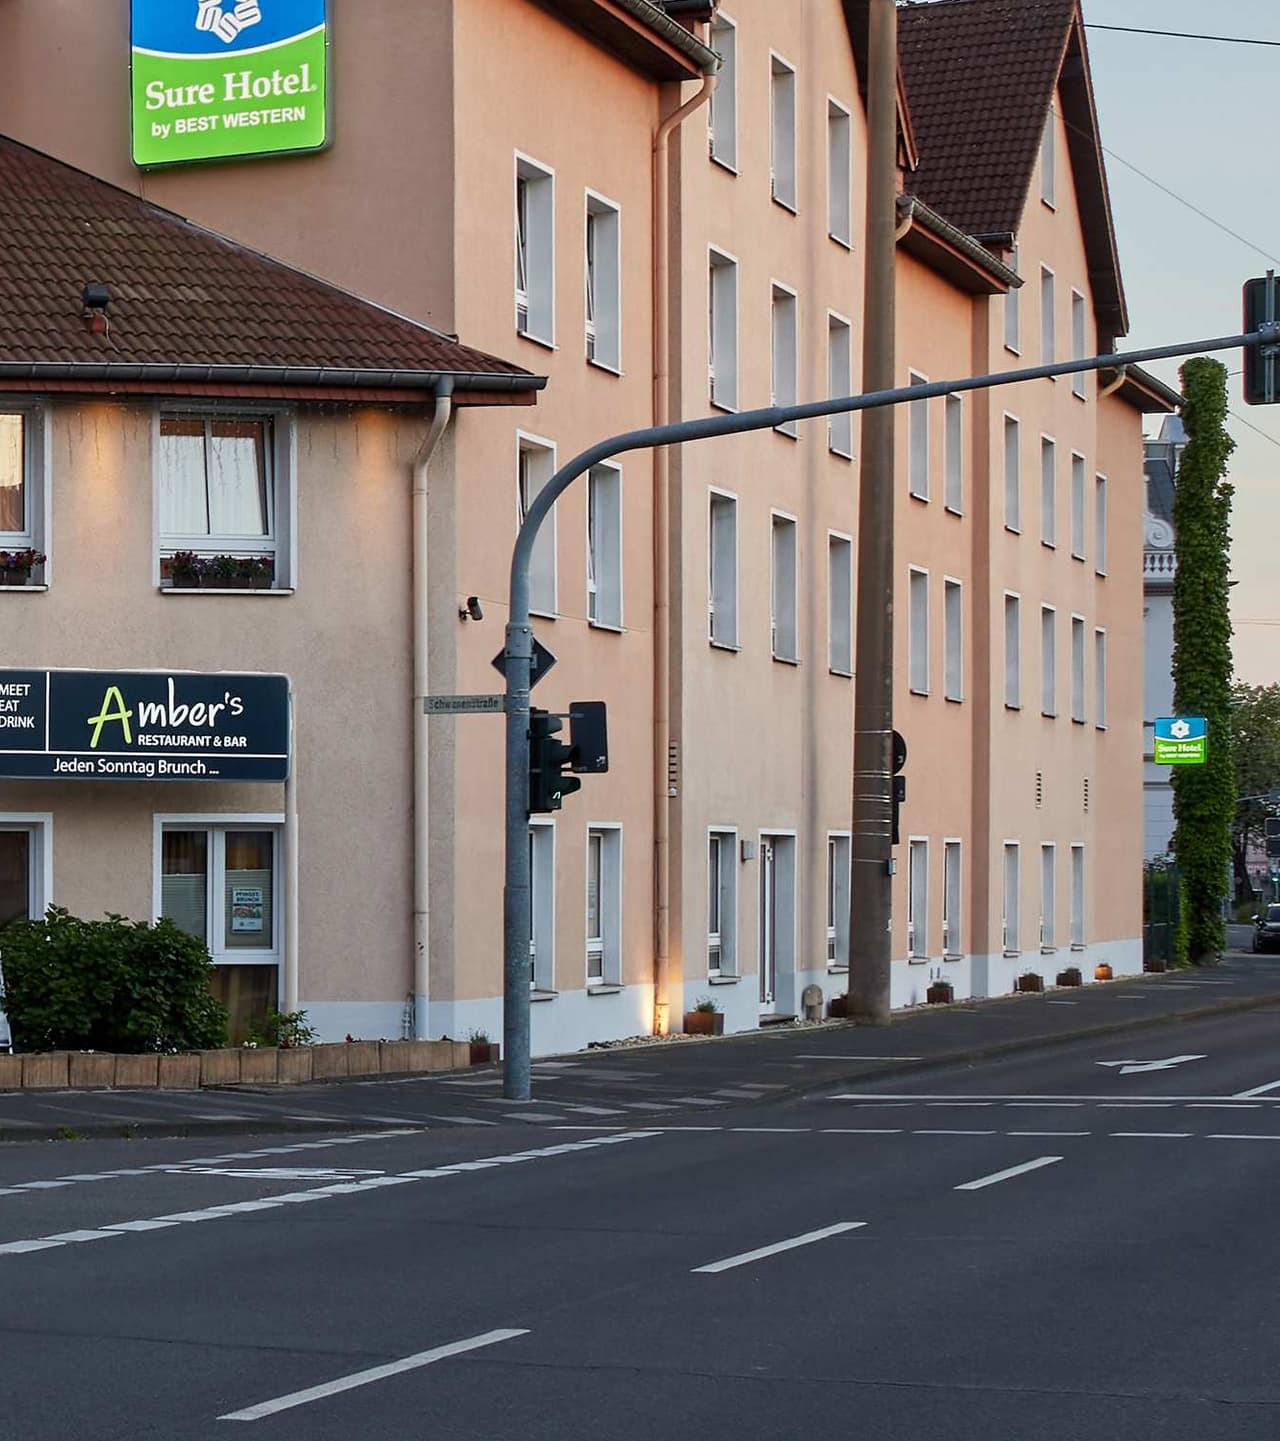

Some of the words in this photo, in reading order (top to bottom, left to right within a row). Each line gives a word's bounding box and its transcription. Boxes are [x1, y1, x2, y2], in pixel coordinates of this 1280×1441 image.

[145, 80, 215, 111] Sure
[223, 63, 313, 102] Hotel
[151, 122, 170, 139] by
[175, 115, 219, 134] BEST
[222, 106, 306, 129] WESTERN
[87, 677, 244, 748] Amber's
[138, 734, 212, 747] RESTAURANT
[213, 736, 222, 747] &
[223, 736, 247, 747] BAR
[53, 758, 95, 774] Jeden
[97, 759, 155, 777] Sonntag
[158, 759, 206, 774] Brunch
